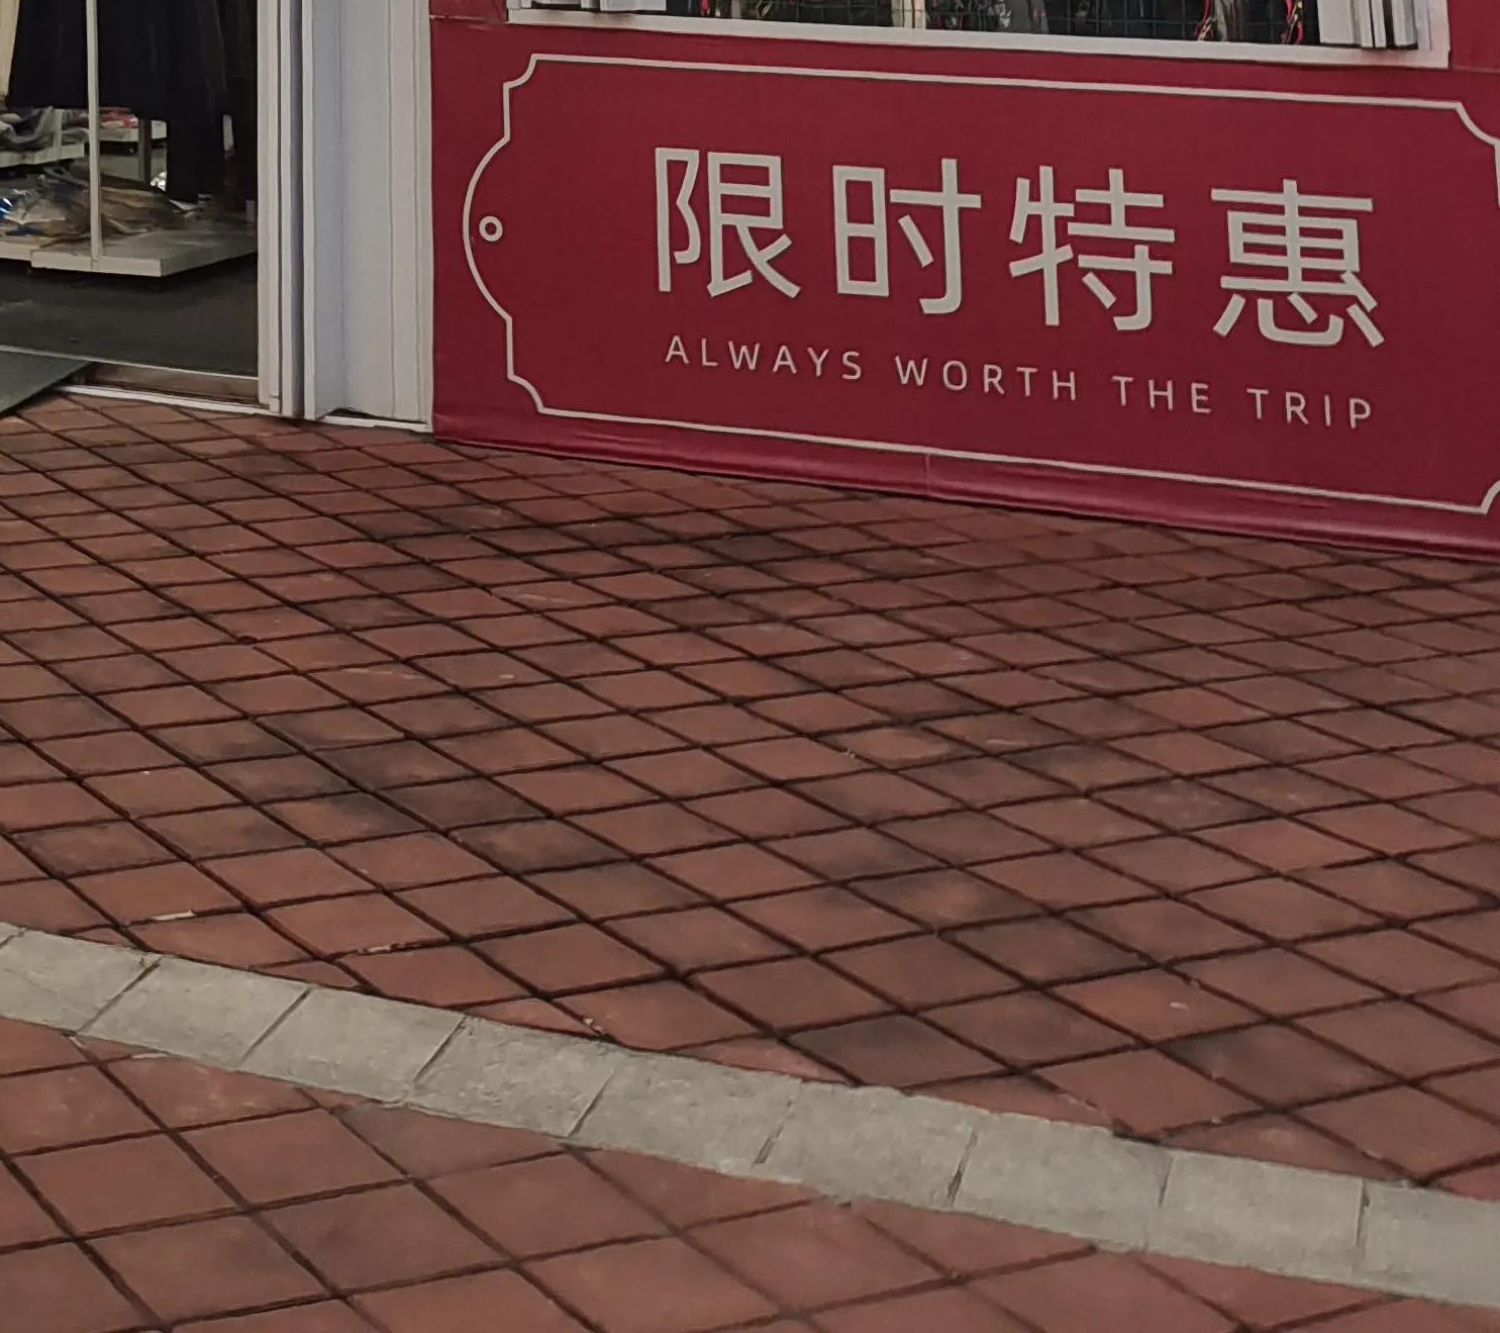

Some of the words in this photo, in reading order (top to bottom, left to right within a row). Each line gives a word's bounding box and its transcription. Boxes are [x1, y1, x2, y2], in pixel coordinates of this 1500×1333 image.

[654, 144, 1385, 349] 限时特惠
[665, 334, 864, 382] ALWAYS
[895, 355, 1078, 403] WORTH
[1111, 375, 1214, 414] THE
[1246, 388, 1376, 430] TRIP
